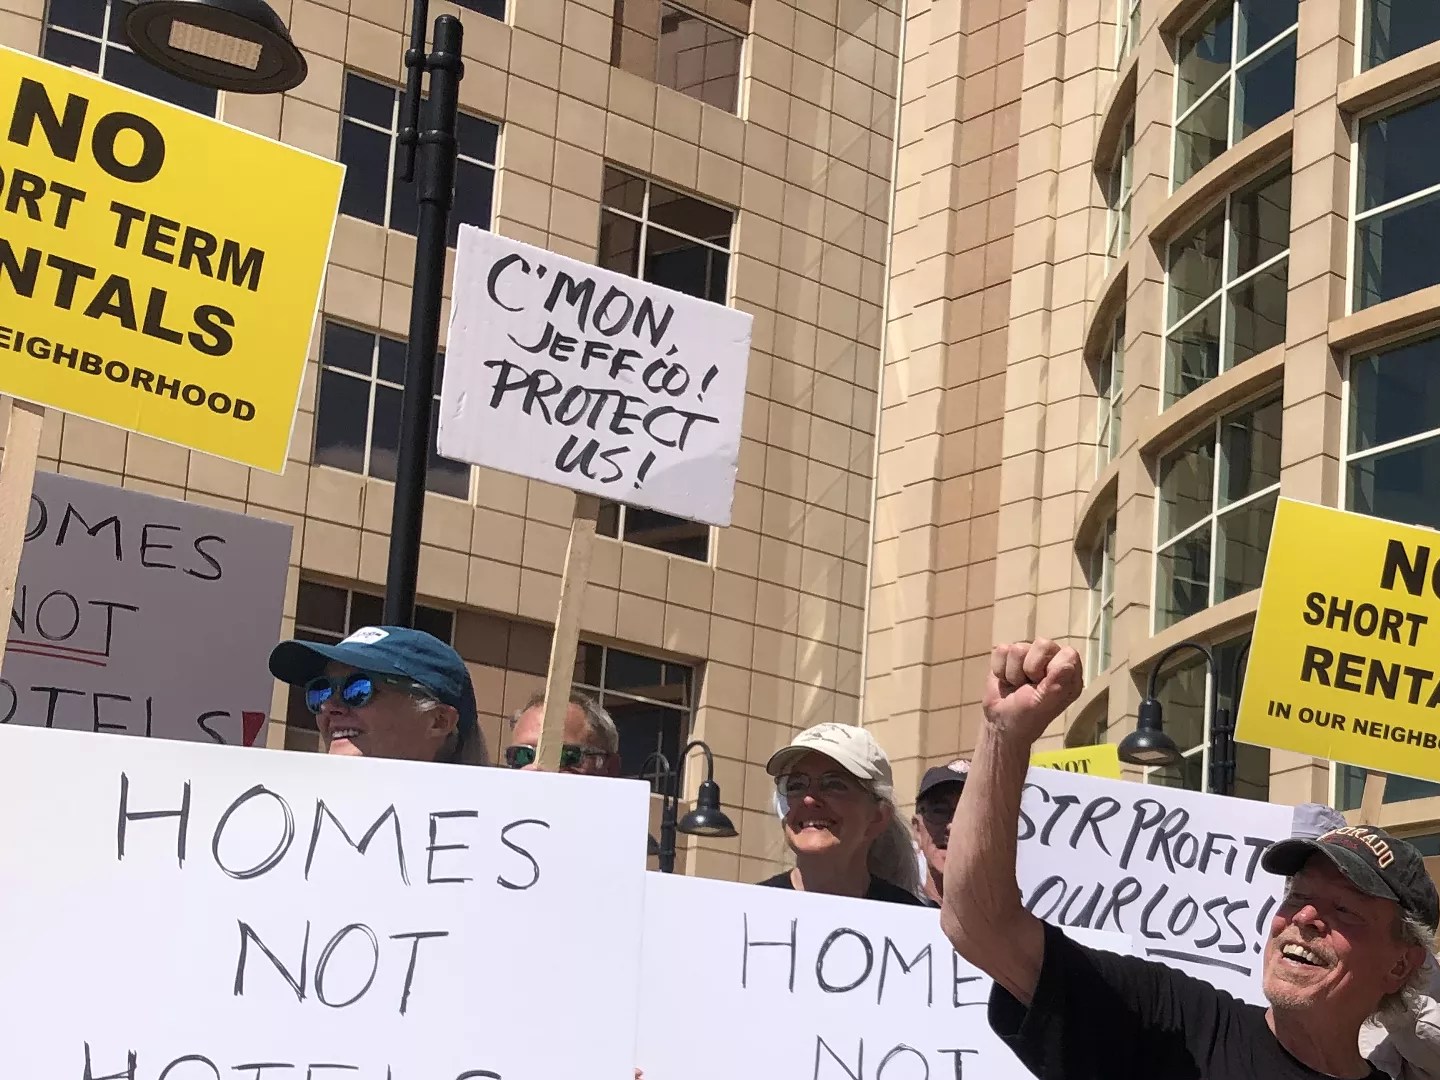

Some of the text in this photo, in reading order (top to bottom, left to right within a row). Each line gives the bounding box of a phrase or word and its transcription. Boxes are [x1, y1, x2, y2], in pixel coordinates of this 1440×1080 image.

[8, 77, 165, 183] NO
[0, 164, 265, 293] RT TERM
[487, 253, 679, 356] C'MON,
[483, 358, 720, 451] PROTECT
[554, 434, 656, 490] US!
[1302, 591, 1428, 647] SHORT
[1267, 700, 1292, 719] IN
[1298, 706, 1346, 731] OUR
[117, 771, 550, 890] HOMES
[233, 919, 449, 1016] NOT
